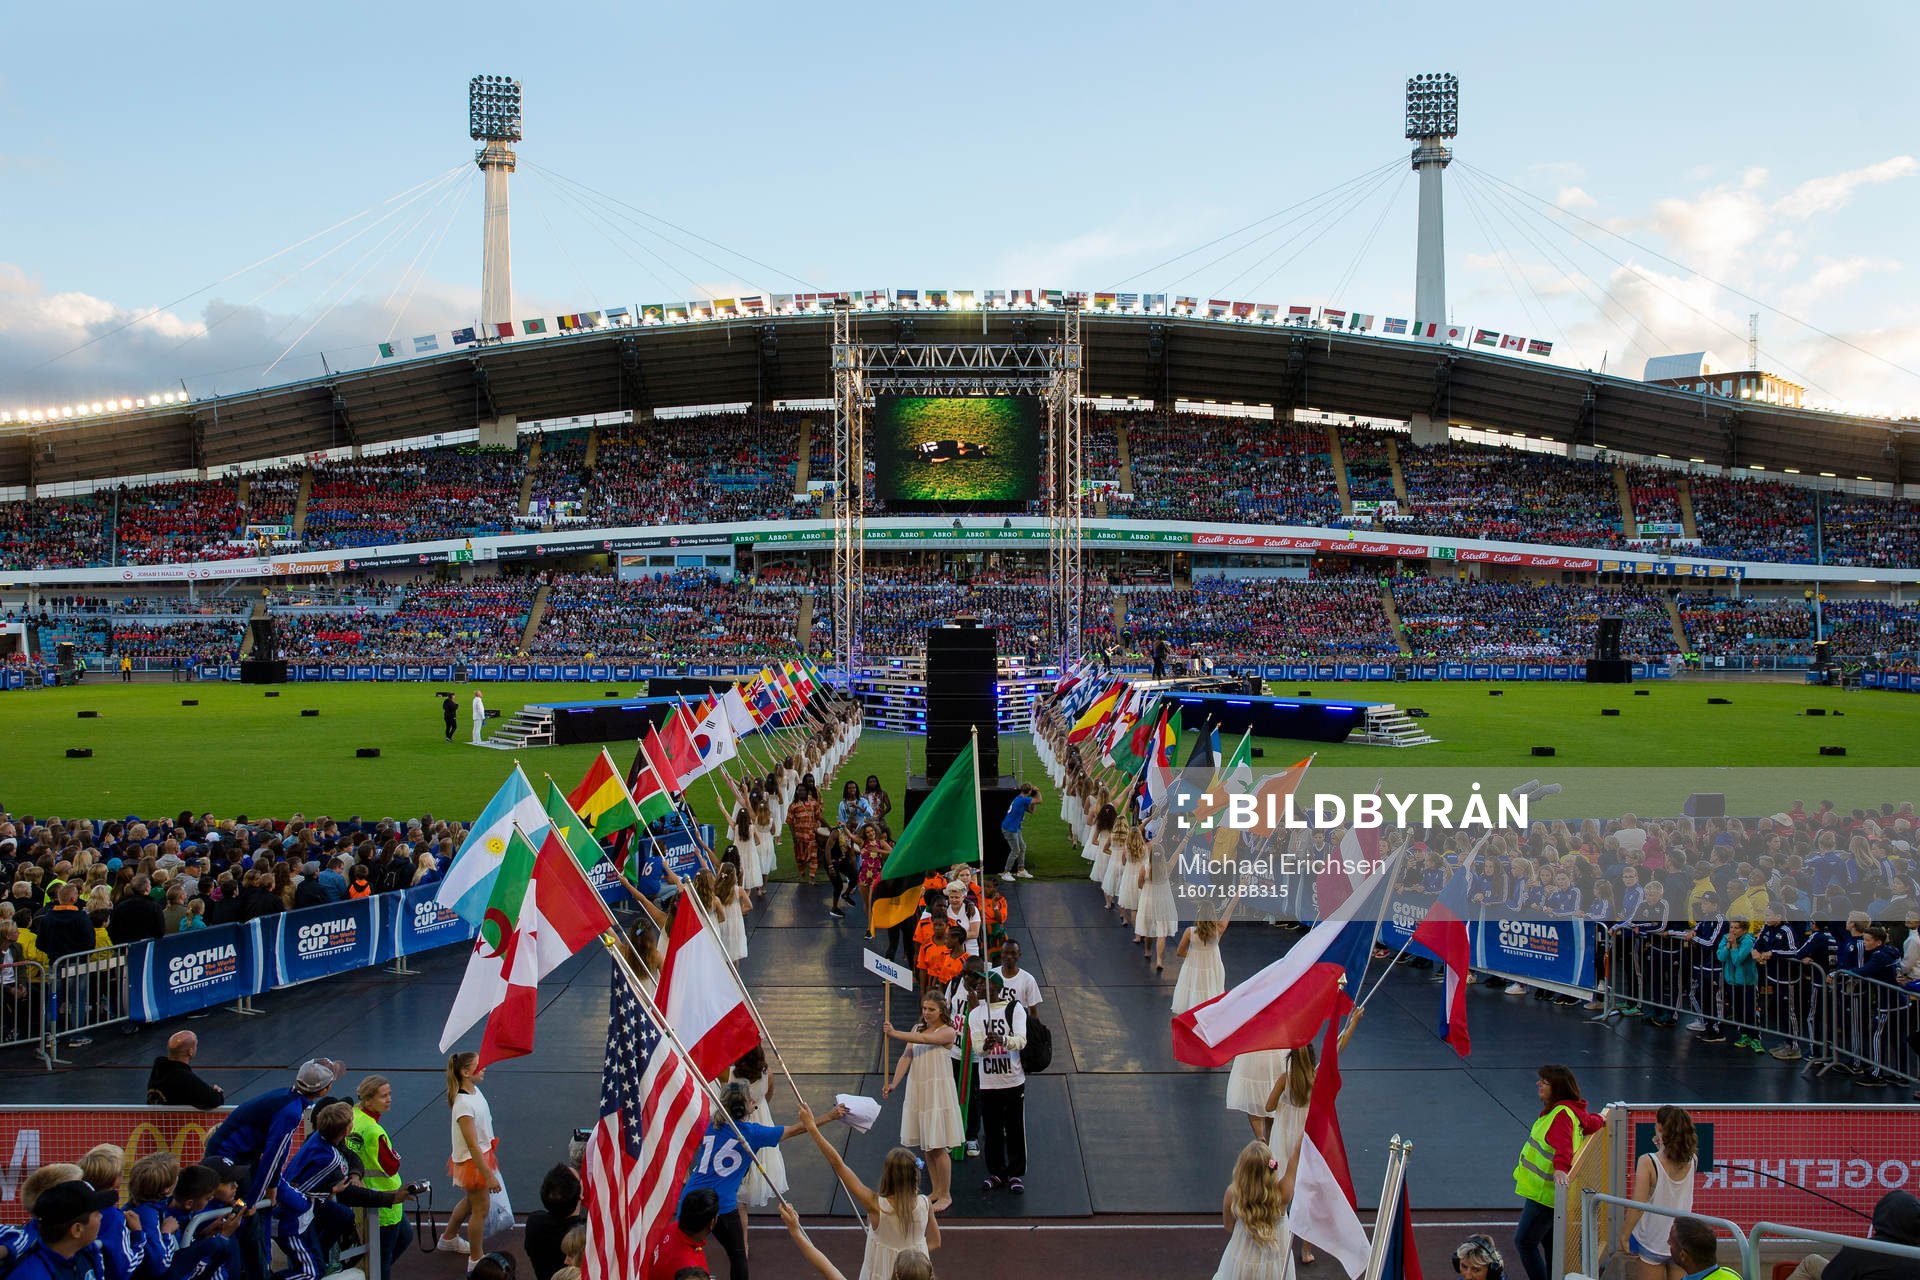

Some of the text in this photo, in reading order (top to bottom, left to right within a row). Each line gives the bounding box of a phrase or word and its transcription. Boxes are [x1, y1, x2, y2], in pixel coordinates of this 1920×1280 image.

[1198, 536, 1224, 544] Estrella
[1264, 538, 1290, 547] Estrella
[1295, 540, 1321, 548] Estrella
[1331, 542, 1357, 550] Estrella
[1398, 547, 1425, 555] Estrella
[288, 562, 329, 574] Renova
[1393, 902, 1428, 919] GOTHI
[414, 912, 437, 927] CUP
[1393, 913, 1415, 928] CUP
[298, 917, 357, 939] GOTHIA
[1498, 919, 1559, 940] GOTHIA
[298, 936, 329, 952] CUP
[1499, 932, 1528, 947] CUP
[169, 944, 236, 971] GOTHIA
[169, 966, 204, 986] CUP
[875, 958, 898, 979] Zambia
[983, 1018, 1005, 1036] YES
[983, 1058, 1012, 1074] CAN!
[698, 1136, 742, 1177] 16
